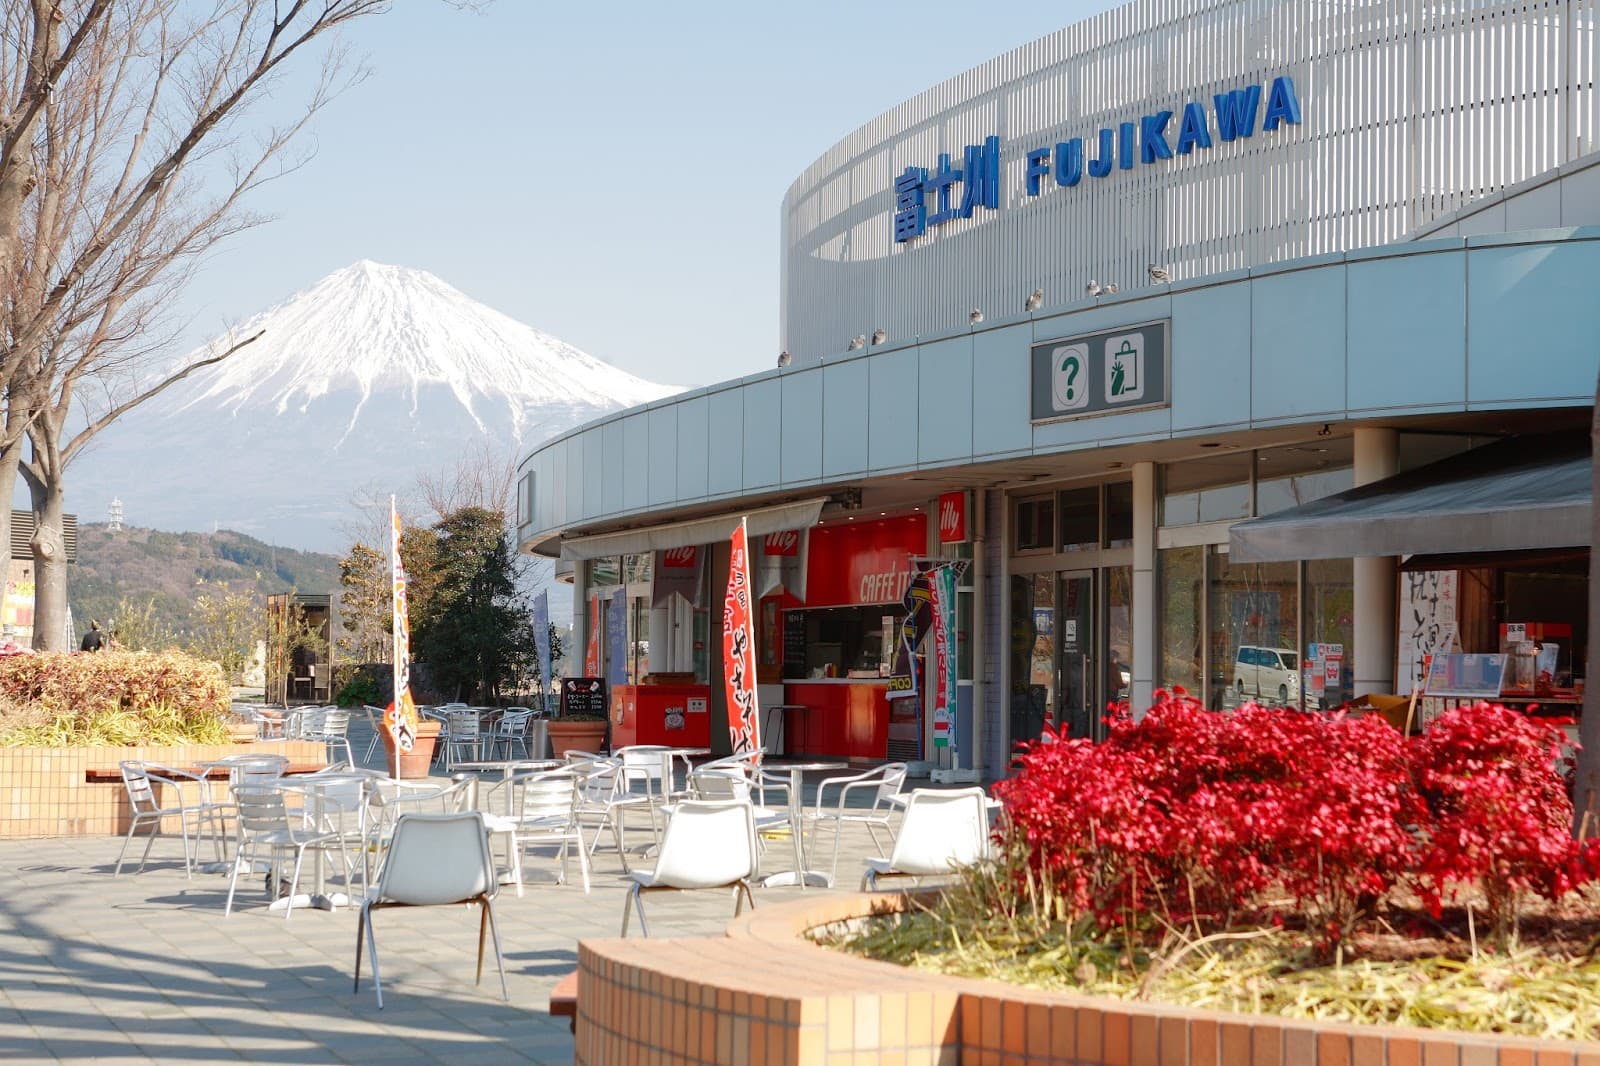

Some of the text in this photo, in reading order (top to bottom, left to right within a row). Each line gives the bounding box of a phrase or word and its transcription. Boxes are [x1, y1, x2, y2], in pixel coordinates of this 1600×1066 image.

[895, 76, 1301, 242] 富士川 FUJIKAWA
[940, 502, 959, 534] illy
